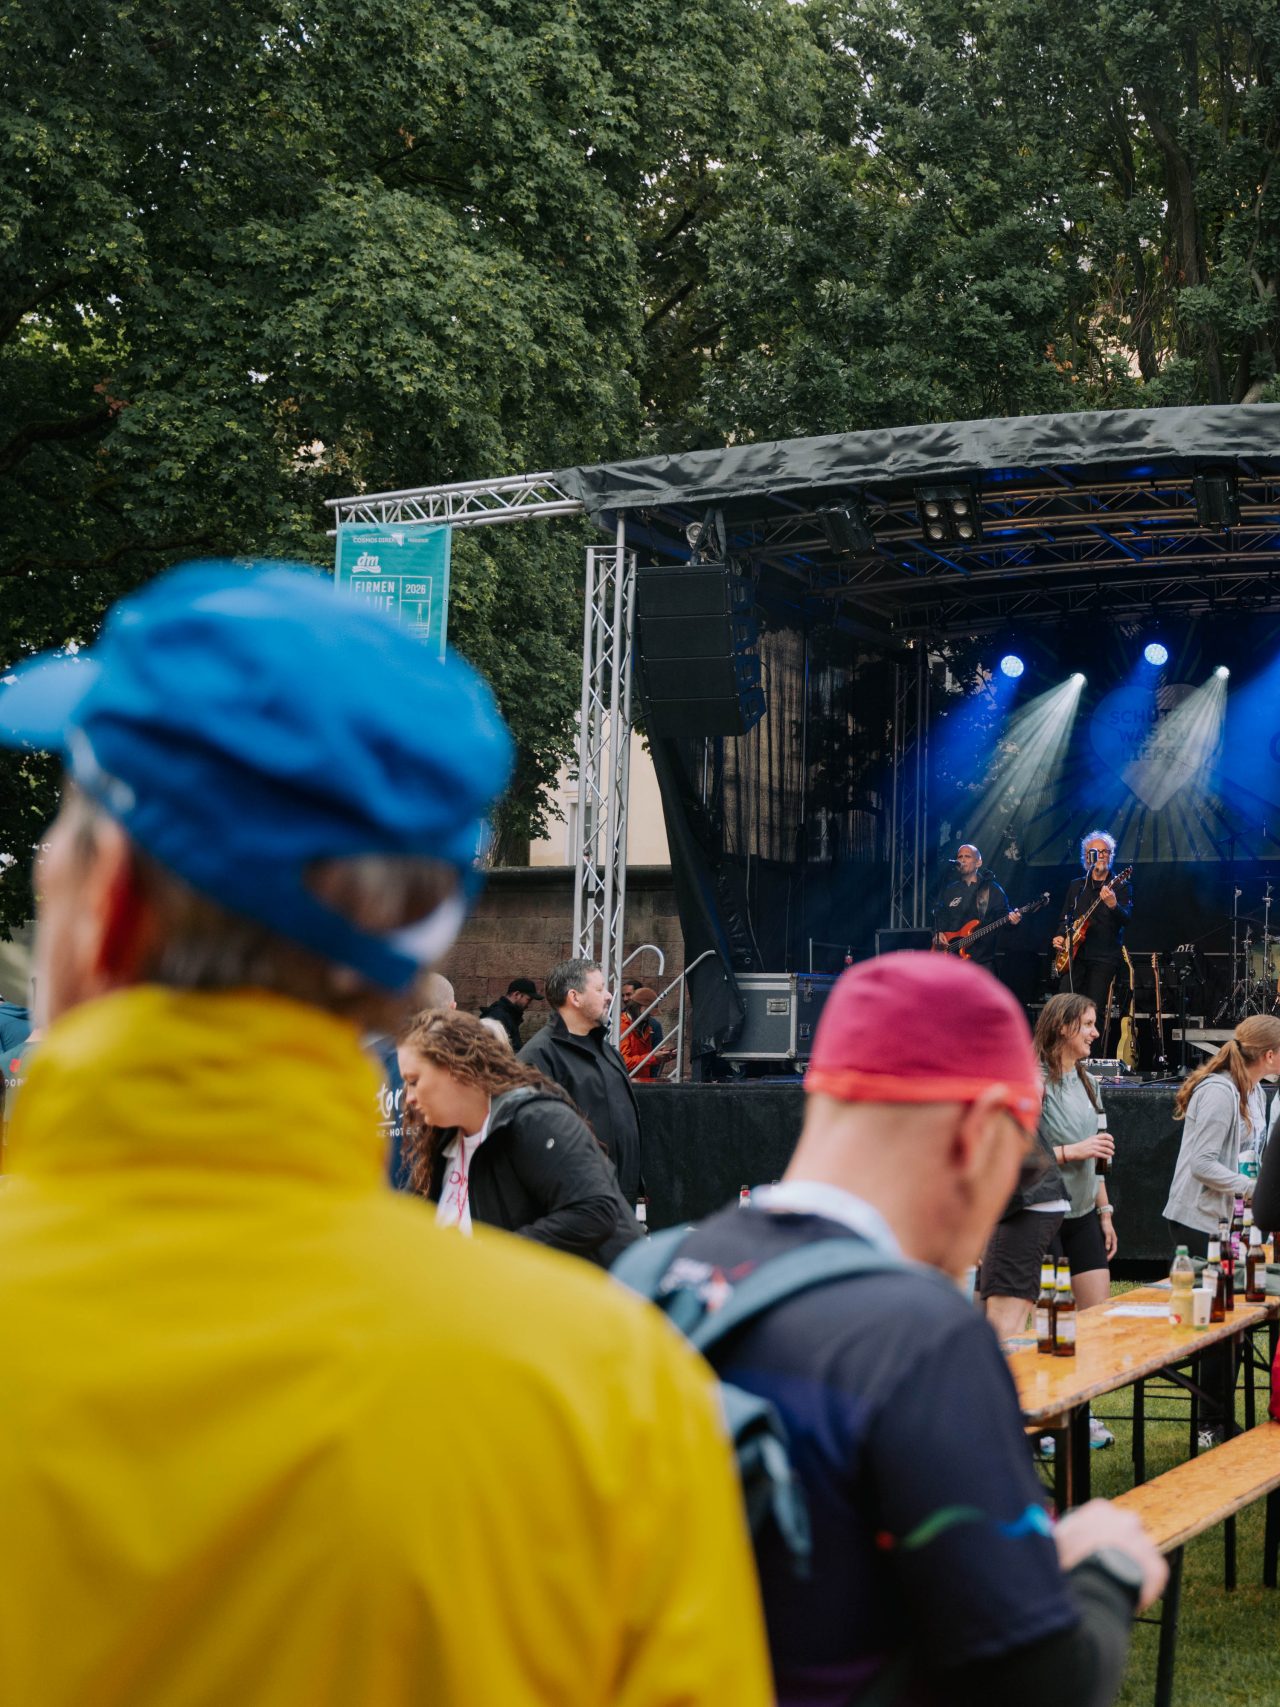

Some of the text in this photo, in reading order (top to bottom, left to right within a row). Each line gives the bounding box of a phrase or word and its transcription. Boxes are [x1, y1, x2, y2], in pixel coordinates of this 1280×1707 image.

[357, 552, 379, 566] dm
[355, 581, 395, 593] FIRMEN
[405, 583, 426, 594] 2026
